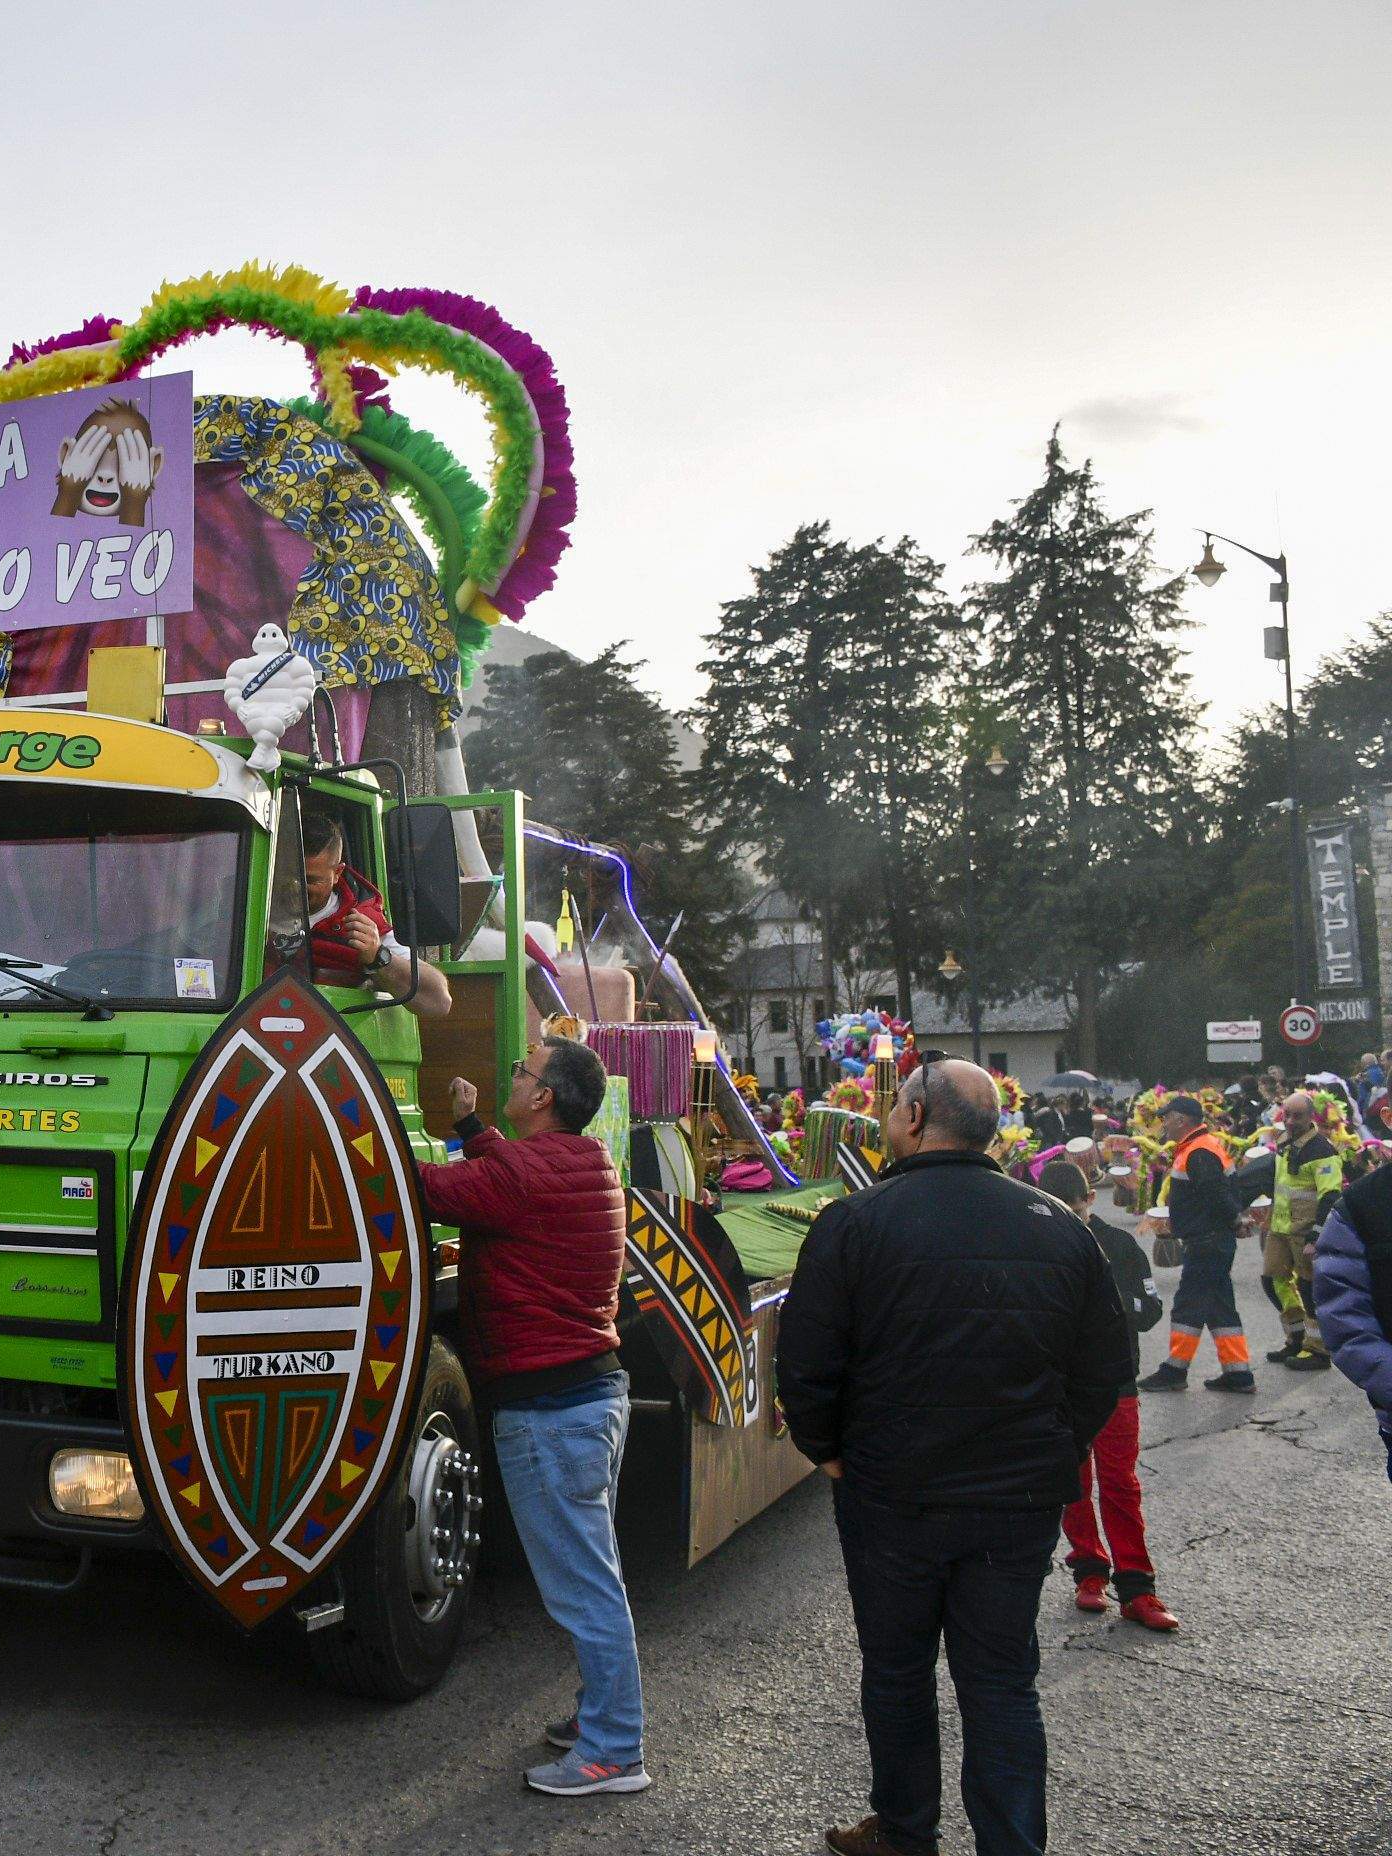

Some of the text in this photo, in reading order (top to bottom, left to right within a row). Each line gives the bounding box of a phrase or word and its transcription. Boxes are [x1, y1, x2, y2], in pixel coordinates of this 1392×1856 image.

[55, 528, 174, 604] VEO
[1314, 834, 1354, 984] TEMPLE
[1289, 1019, 1311, 1032] 30
[62, 1187, 93, 1198] MAGO
[227, 1265, 320, 1290] REINO
[213, 1352, 336, 1378] TURKANO
